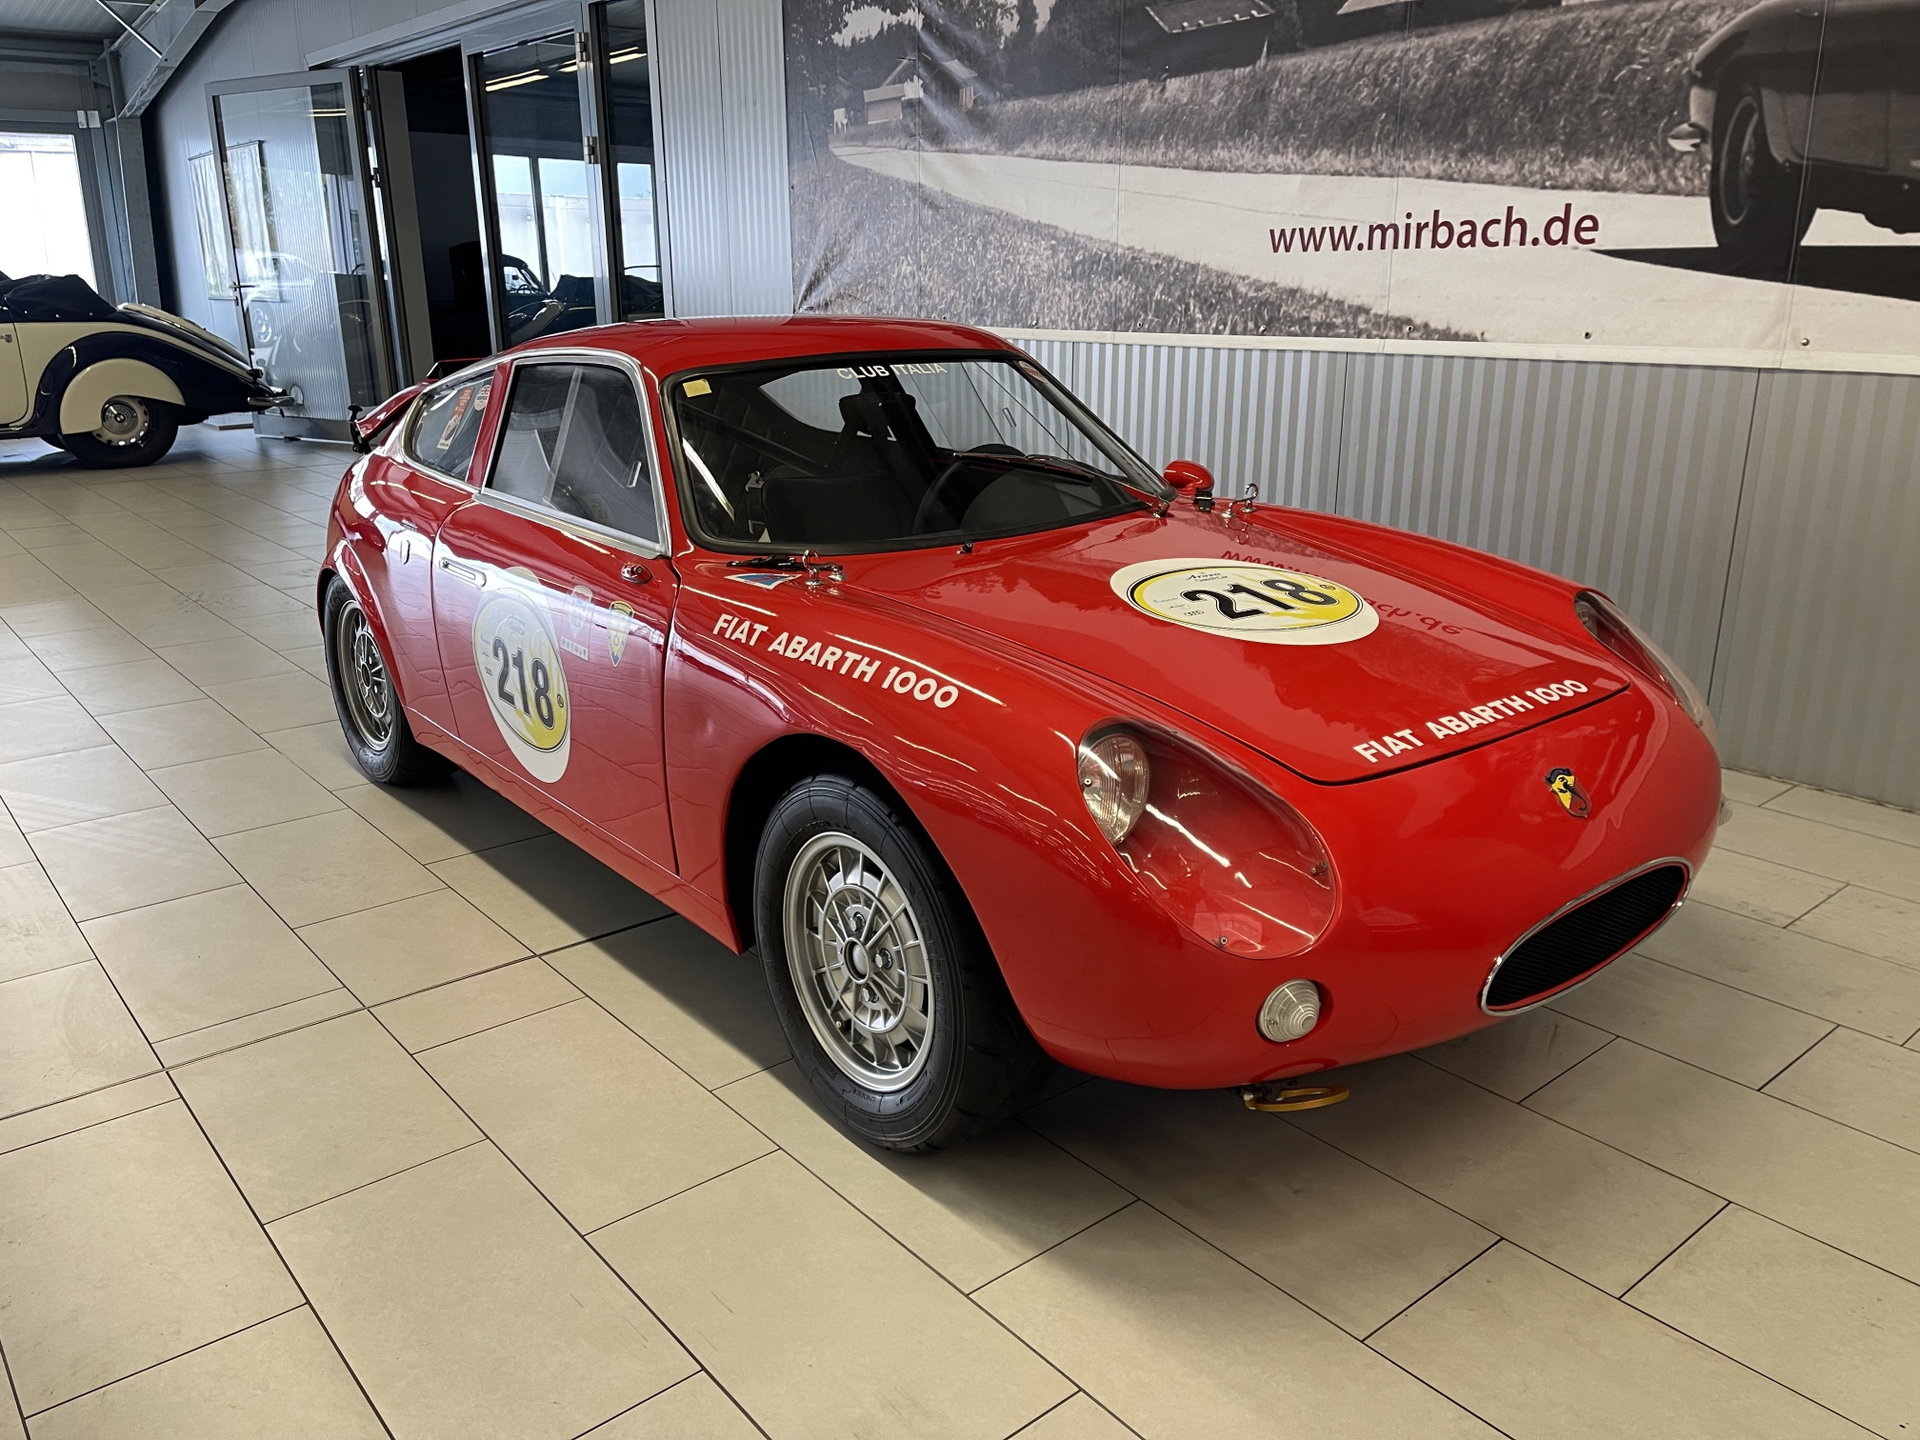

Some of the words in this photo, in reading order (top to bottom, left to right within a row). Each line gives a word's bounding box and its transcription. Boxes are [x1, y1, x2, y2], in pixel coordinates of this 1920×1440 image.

[1268, 202, 1600, 253] www.mirbach.de
[837, 365, 890, 380] CLUB
[890, 362, 948, 376] ITALIA
[1180, 579, 1340, 620] 218
[492, 636, 554, 730] 218
[712, 613, 768, 646] FIAT
[767, 631, 882, 683] ABARTH
[881, 666, 959, 709] 1000
[1353, 729, 1424, 763] FIAT
[1425, 695, 1534, 739] ABARTH
[1525, 679, 1589, 705] 1000
